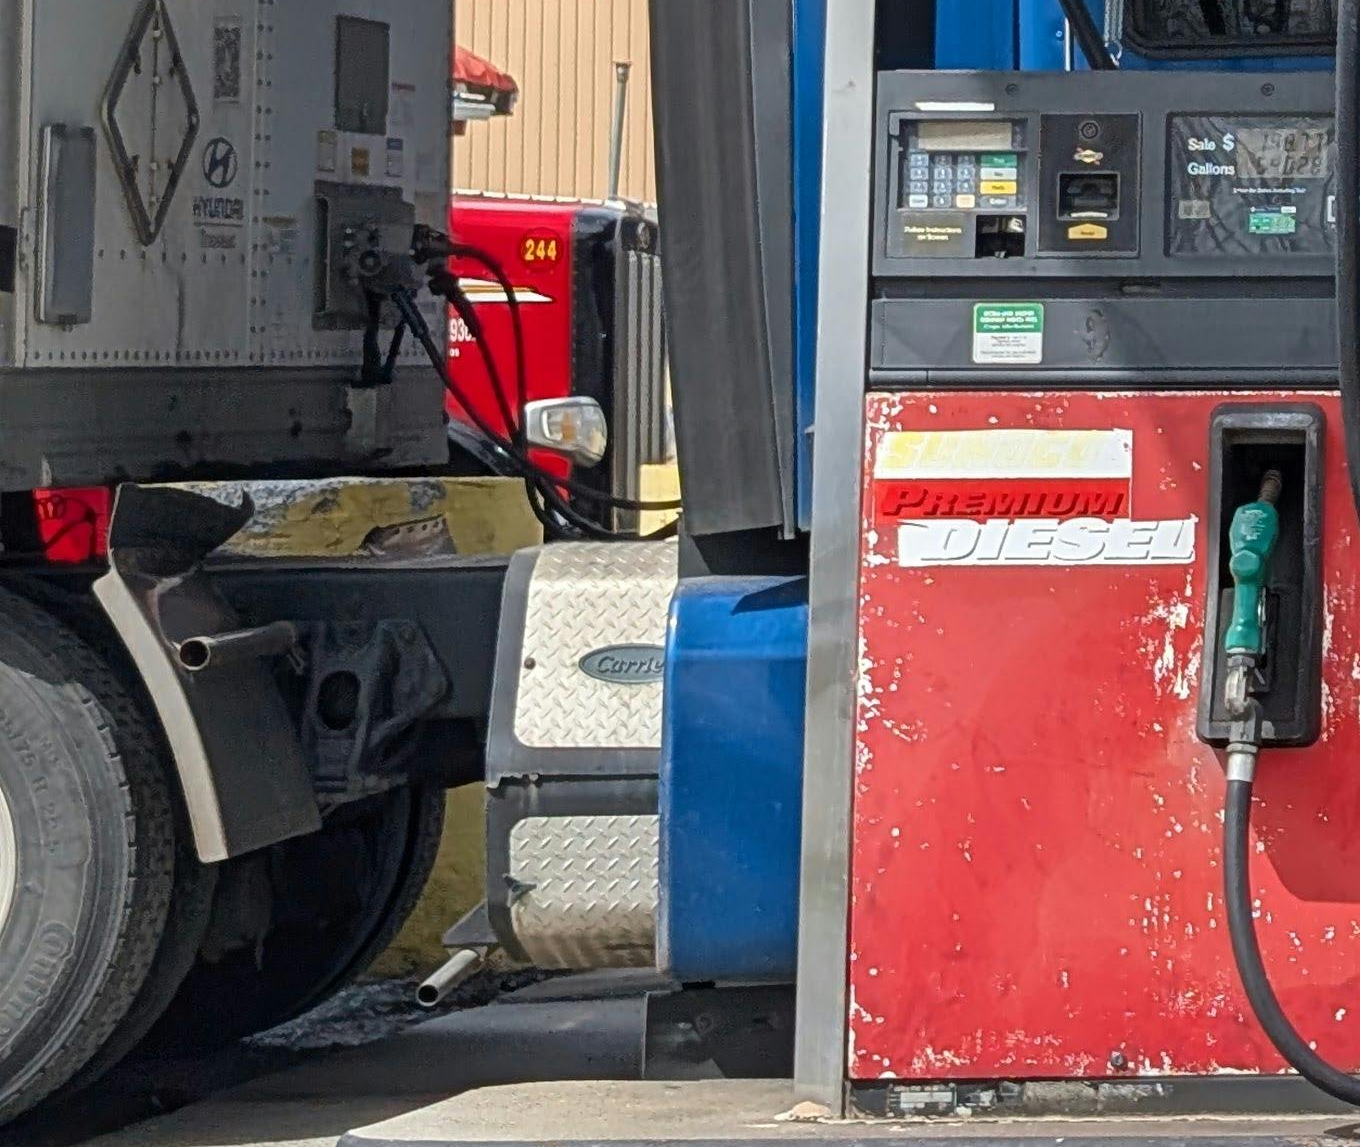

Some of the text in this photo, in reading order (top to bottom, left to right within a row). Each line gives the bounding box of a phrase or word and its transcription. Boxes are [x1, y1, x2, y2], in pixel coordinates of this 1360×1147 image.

[1187, 137, 1216, 151] Sale
[1187, 162, 1236, 176] Gallons
[524, 238, 557, 261] 244
[883, 485, 1125, 517] PREMIUM
[918, 519, 1194, 562] DIESEL
[597, 655, 666, 674] Carrie
